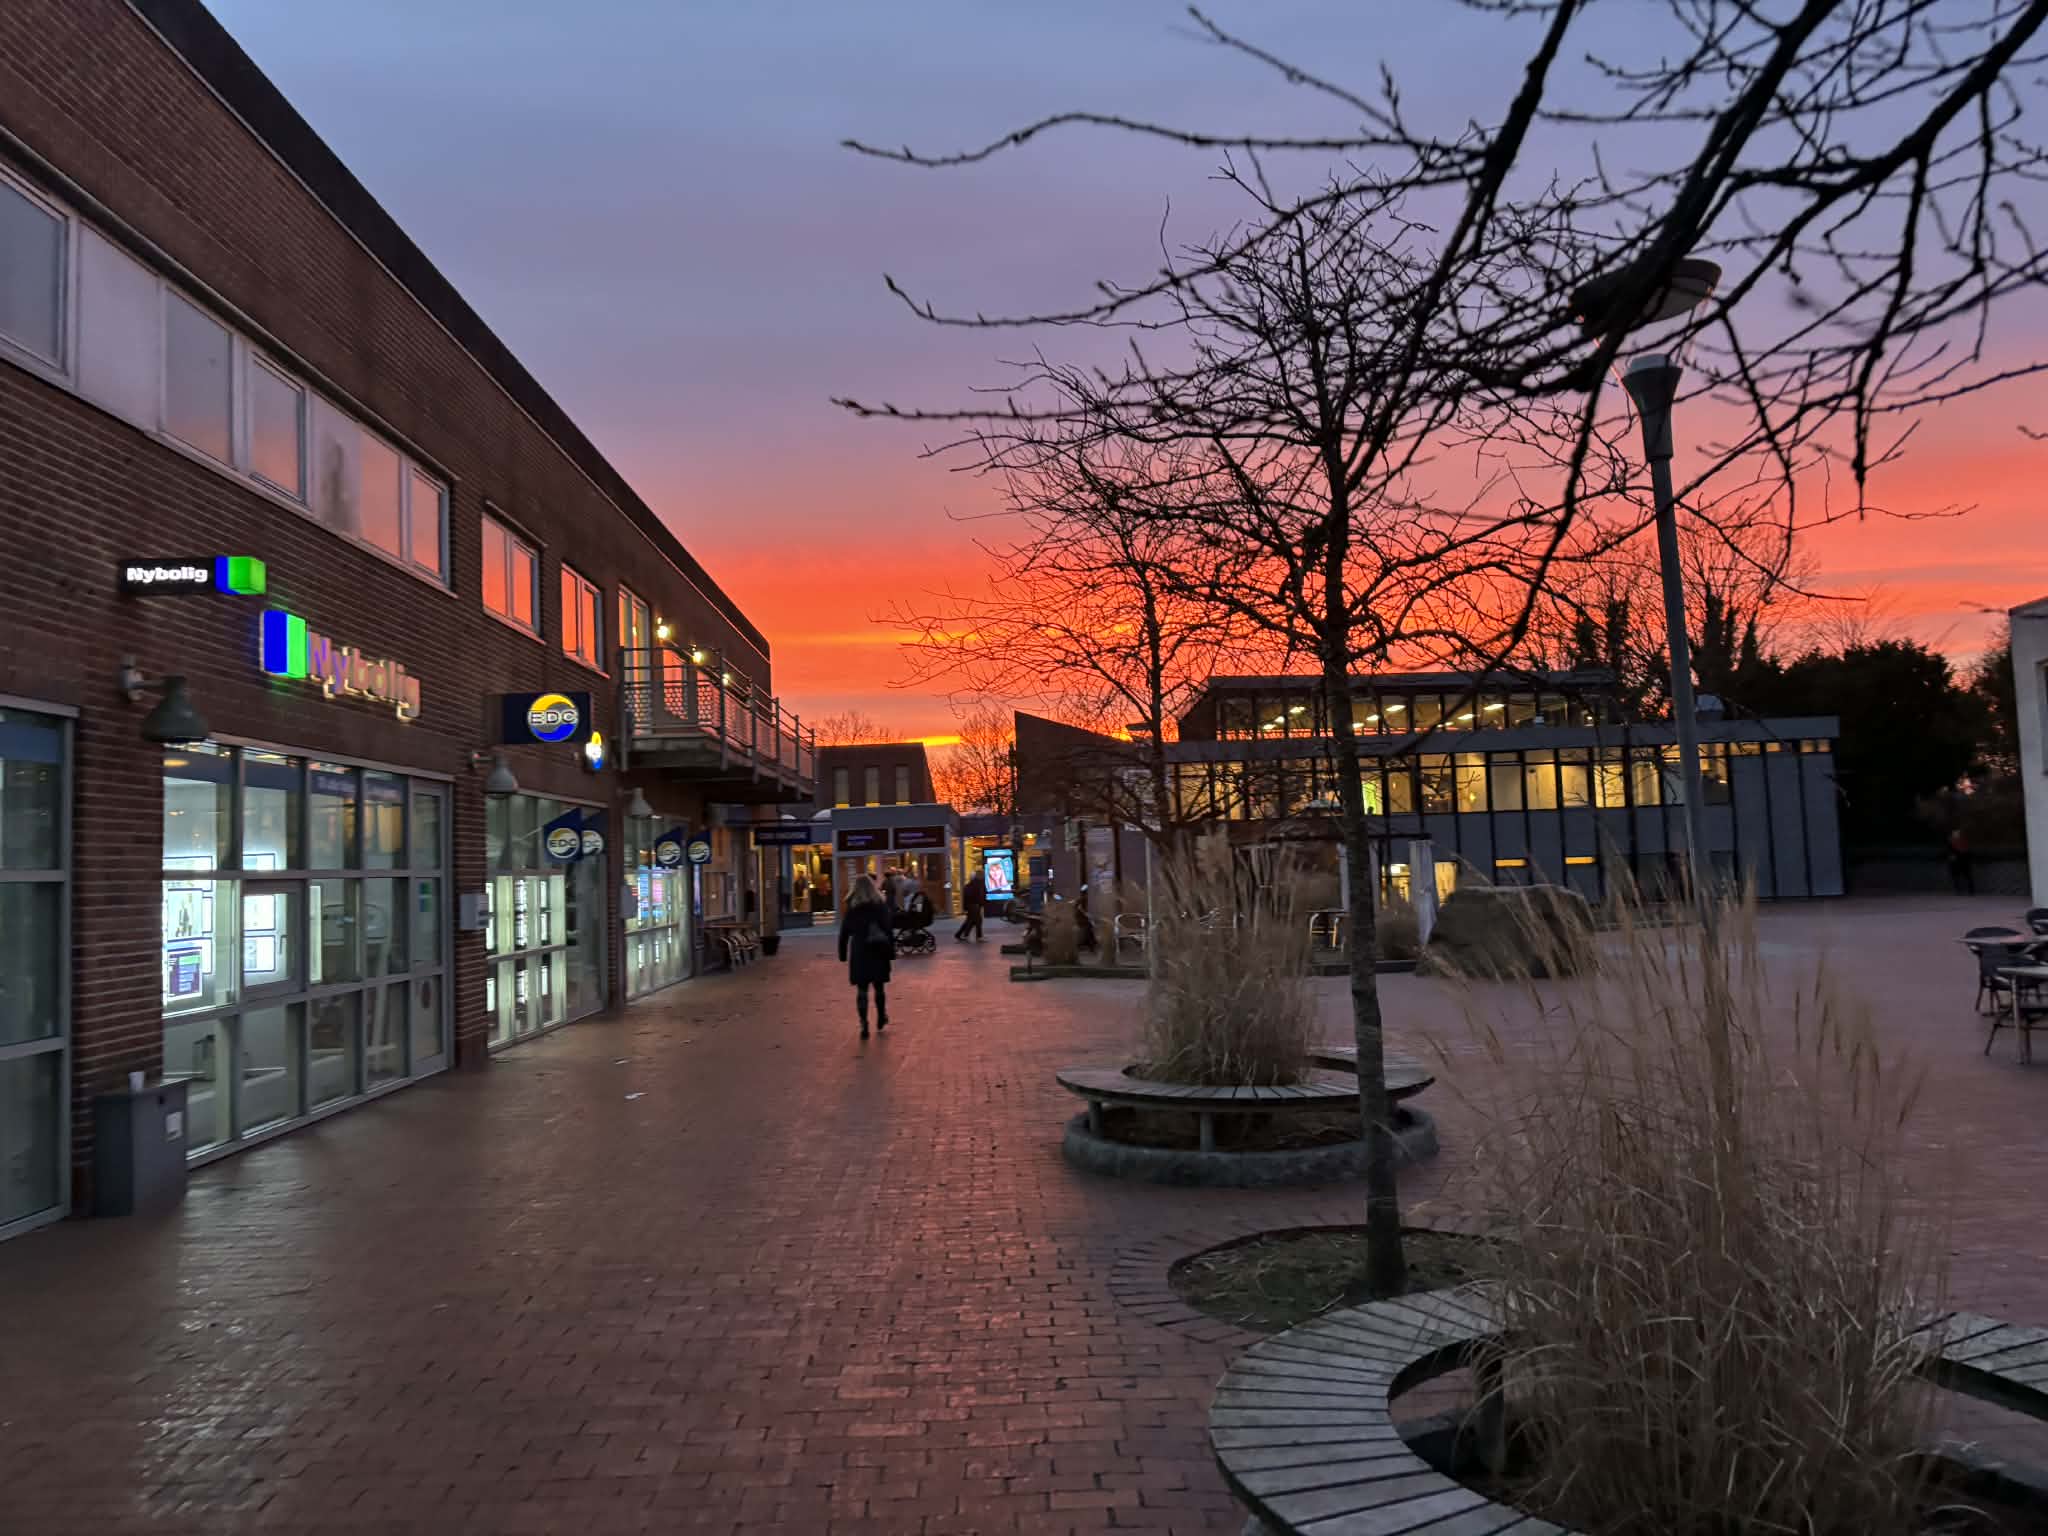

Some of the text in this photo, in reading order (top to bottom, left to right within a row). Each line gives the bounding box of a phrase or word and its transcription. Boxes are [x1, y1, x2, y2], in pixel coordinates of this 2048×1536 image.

[126, 566, 209, 584] Nybolig
[307, 631, 421, 721] Nybolig
[528, 709, 579, 725] EDC
[549, 838, 578, 849] EDC
